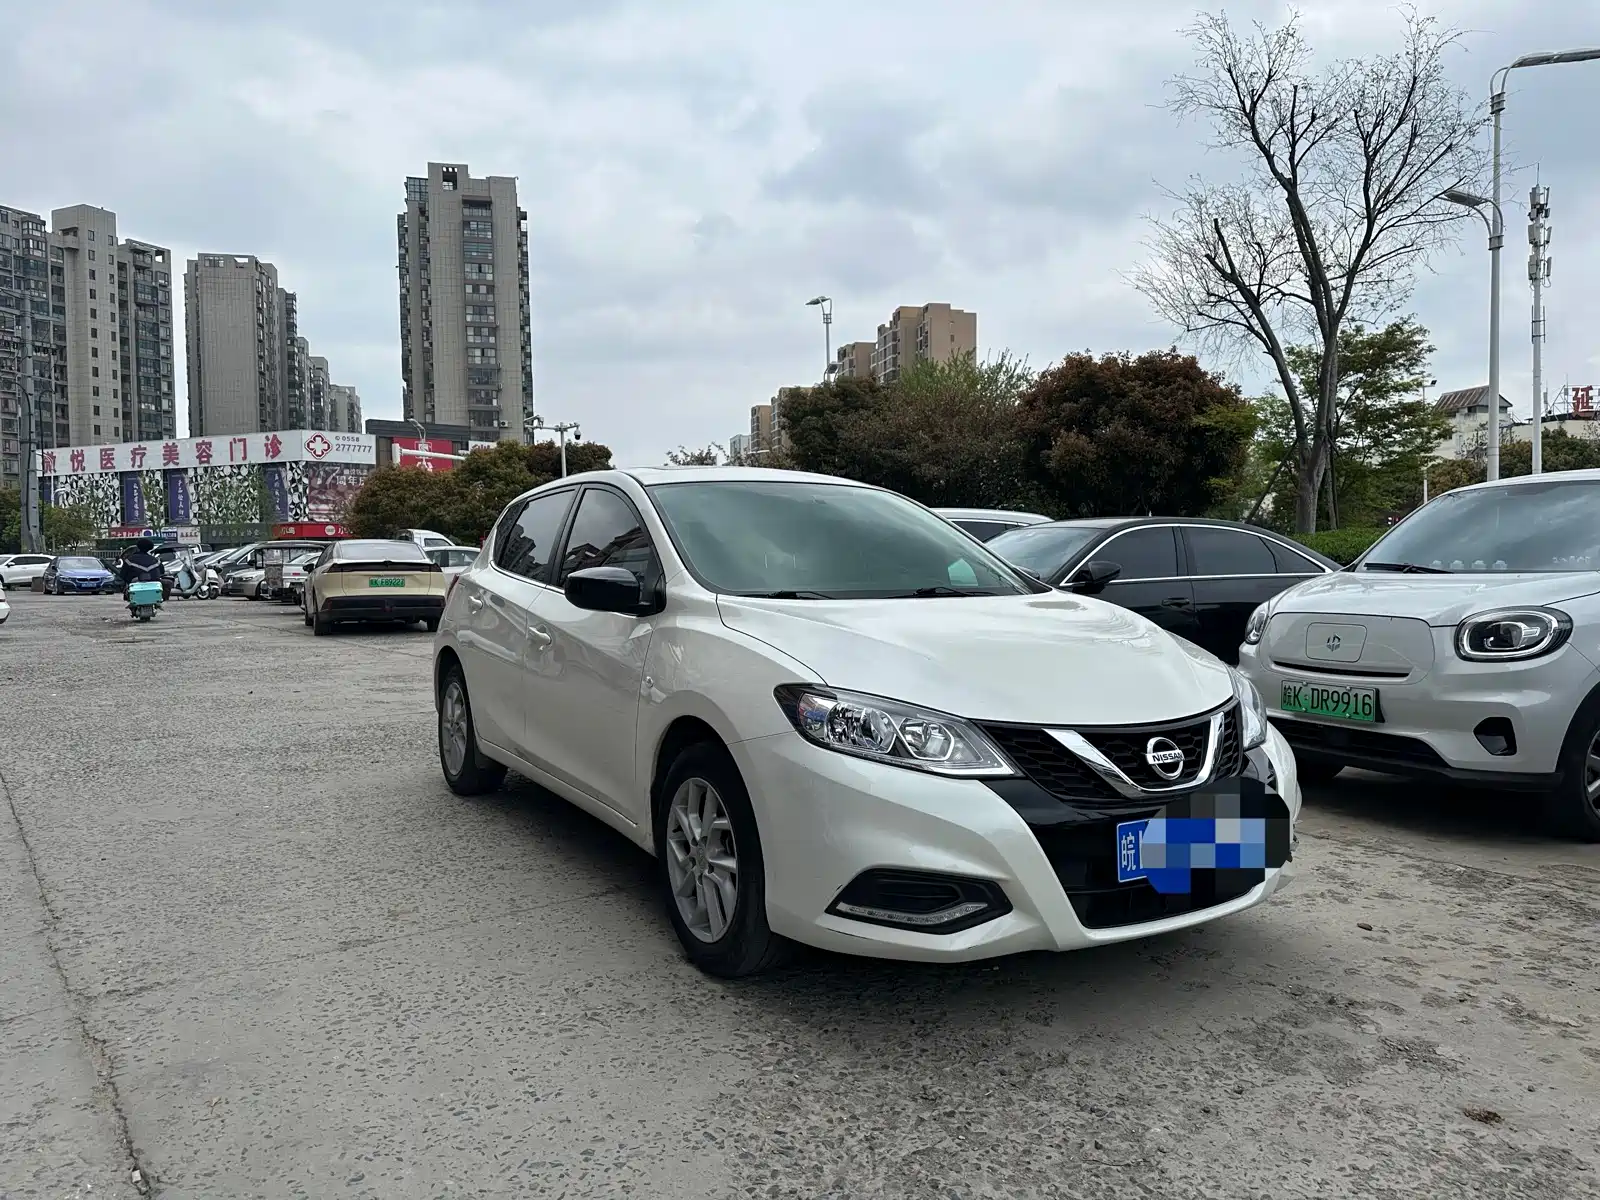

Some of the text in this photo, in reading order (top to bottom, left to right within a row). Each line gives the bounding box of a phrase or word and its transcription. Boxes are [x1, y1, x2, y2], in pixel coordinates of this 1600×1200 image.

[1572, 385, 1594, 417] 延
[341, 435, 360, 443] 0558
[335, 443, 373, 454] 2777777
[1152, 751, 1183, 763] NISSAN
